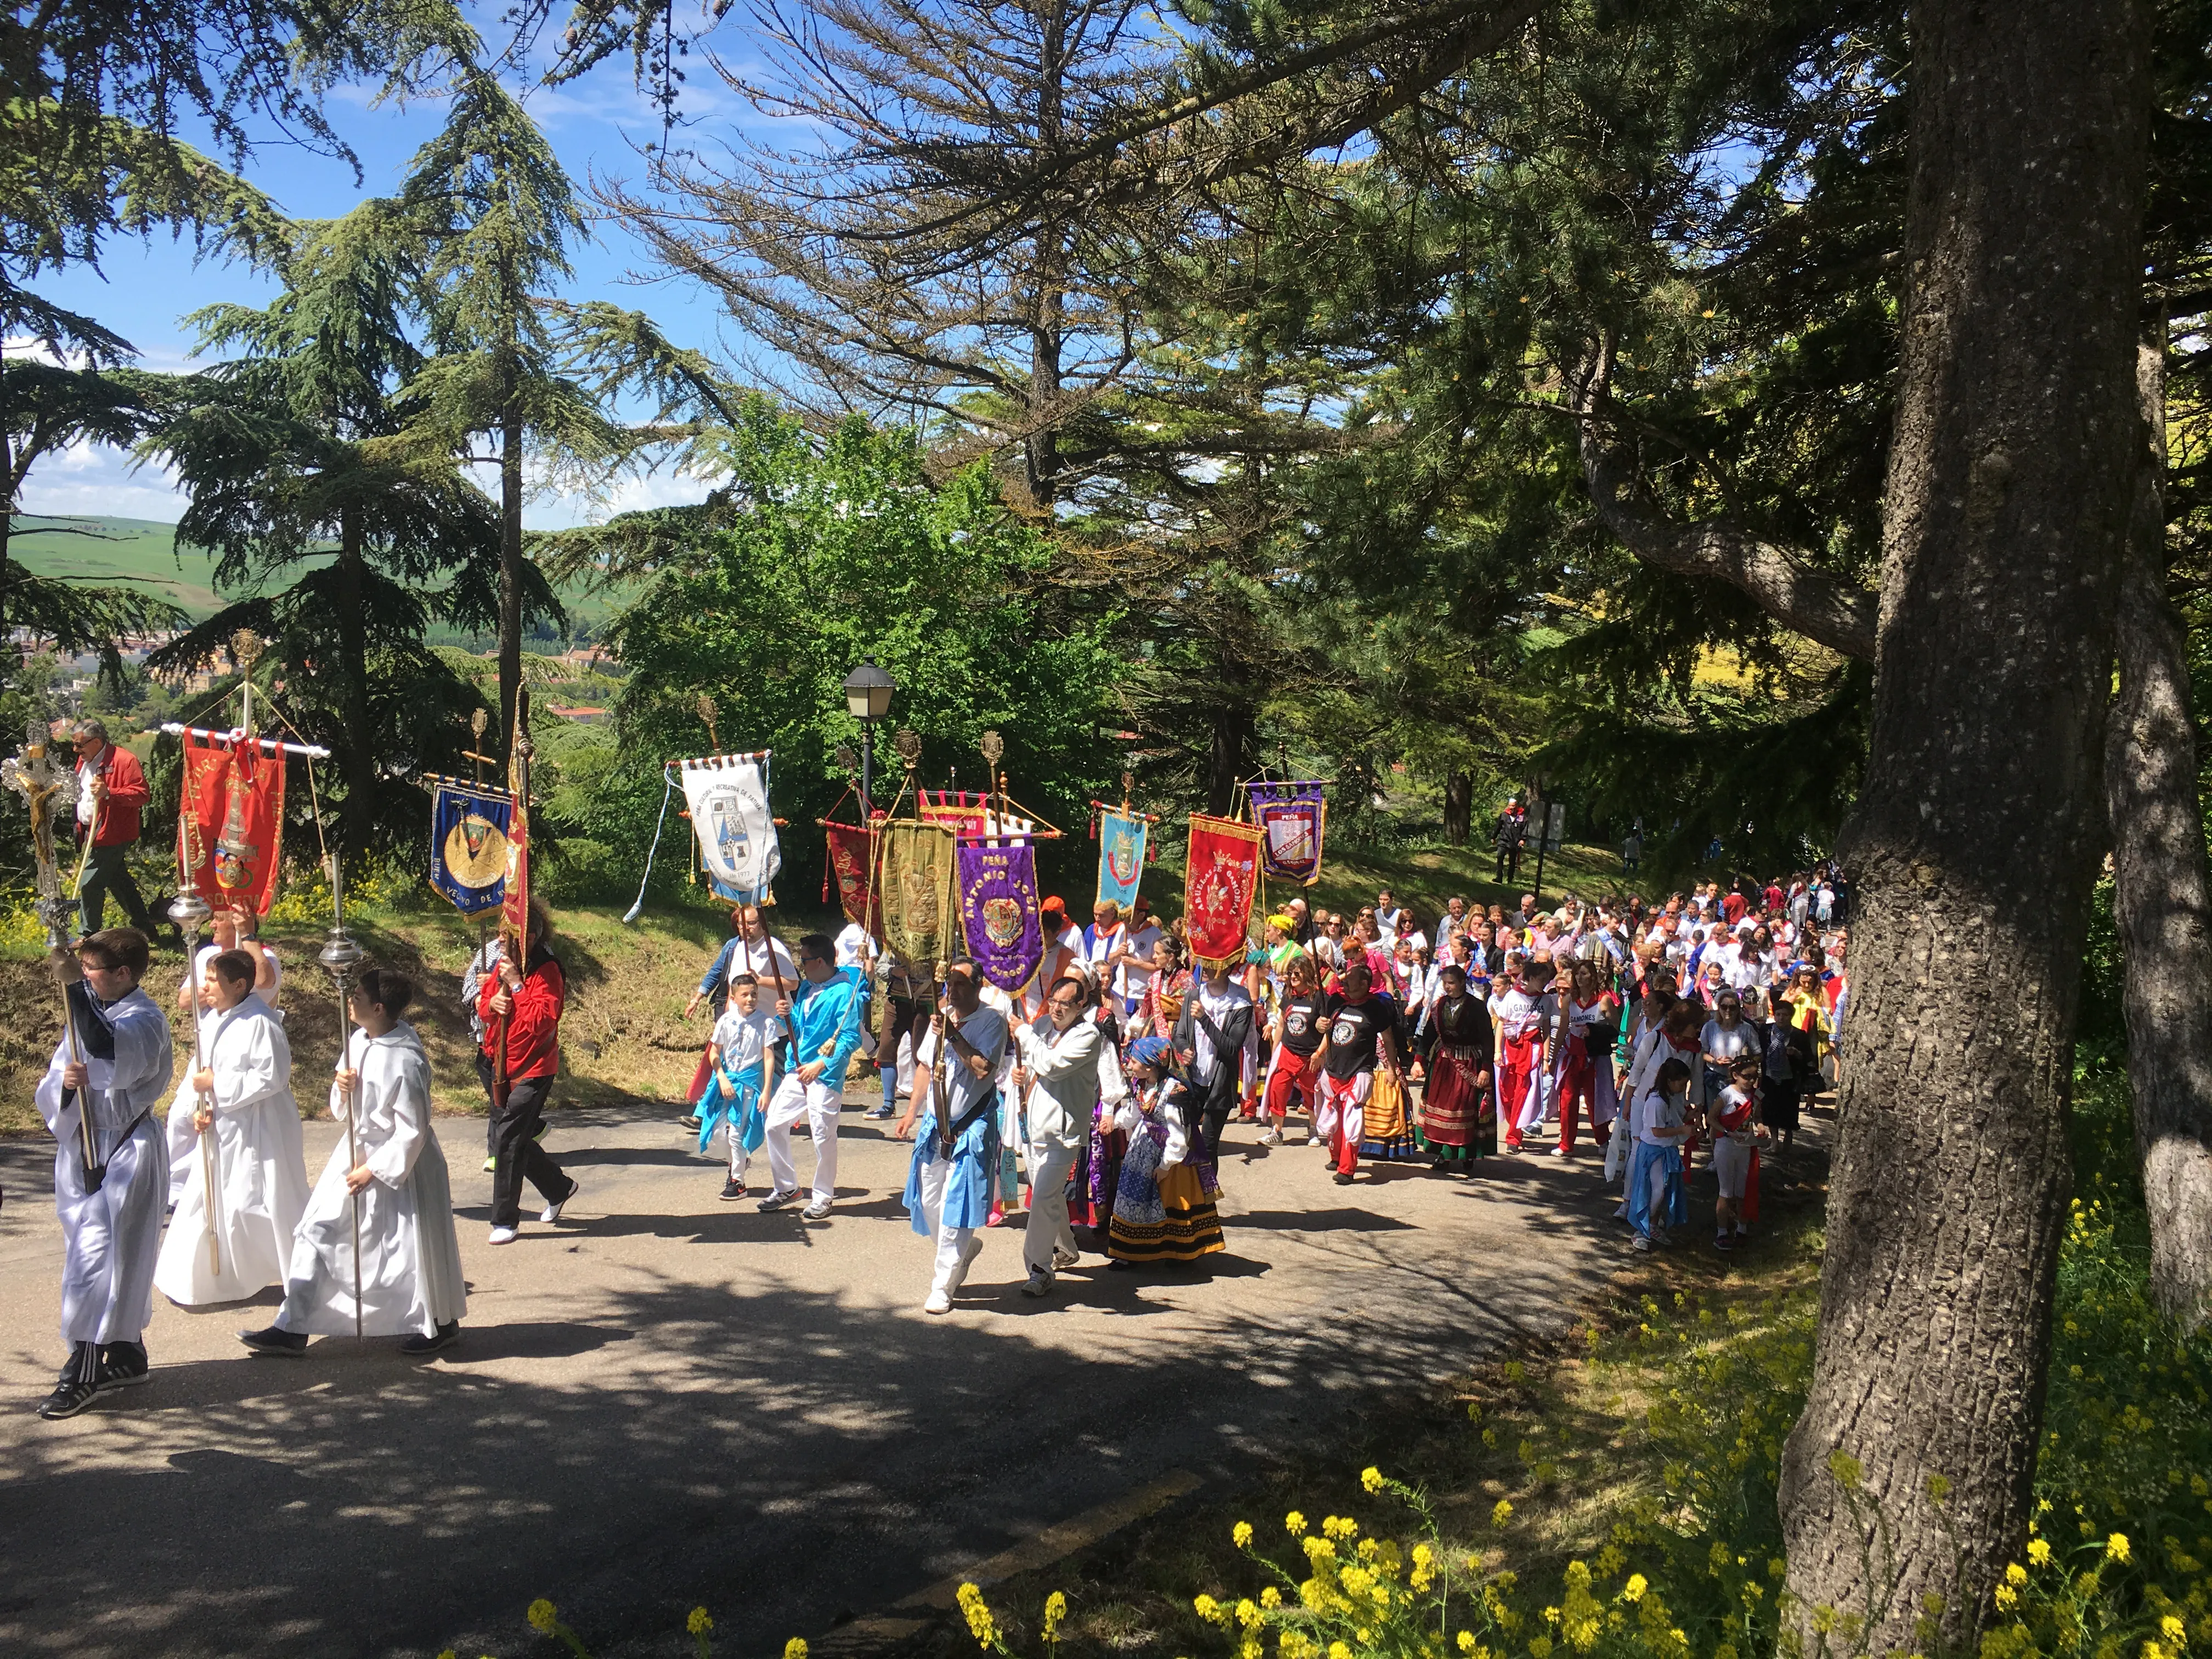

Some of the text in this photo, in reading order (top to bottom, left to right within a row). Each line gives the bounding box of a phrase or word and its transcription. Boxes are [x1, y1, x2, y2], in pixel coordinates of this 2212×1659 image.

[715, 784, 740, 794] RECREATIVA
[740, 789, 748, 797] DE
[1274, 831, 1309, 857] LOS GAMONES
[982, 854, 1009, 867] PEÑA
[432, 857, 441, 880] BUEN
[481, 894, 492, 905] DE
[1195, 869, 1212, 911] ABUELAS
[1226, 870, 1241, 915] GAMONAL
[966, 871, 1006, 919] ANTONIO
[1013, 880, 1036, 915] JOSE
[991, 963, 1025, 978] BURGOS
